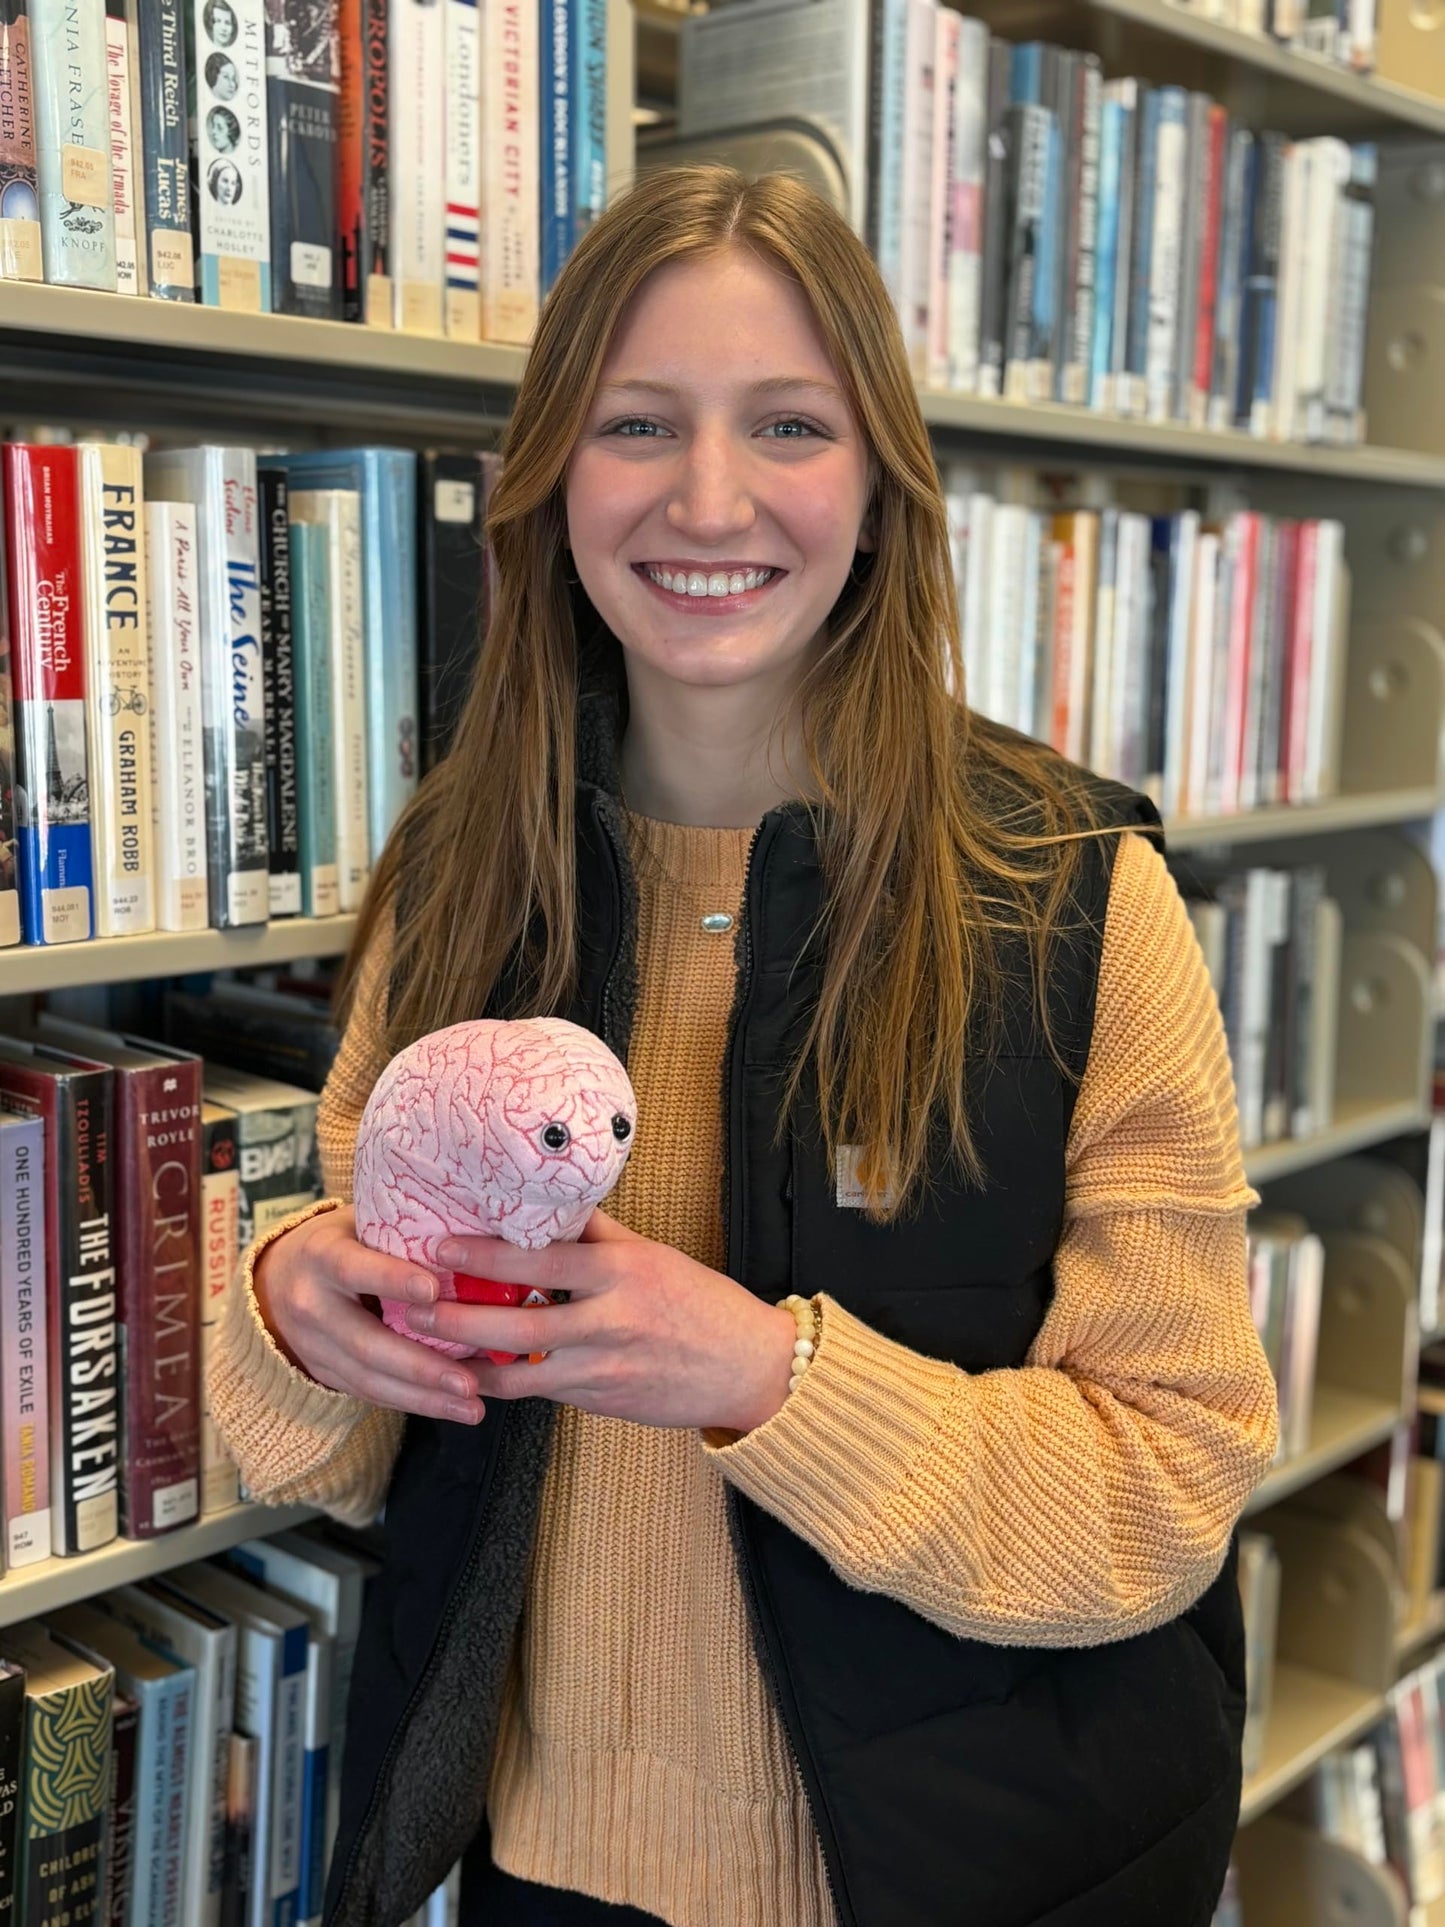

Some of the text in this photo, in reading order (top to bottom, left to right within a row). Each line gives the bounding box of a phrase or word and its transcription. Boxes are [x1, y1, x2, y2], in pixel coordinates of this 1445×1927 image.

[161, 11, 177, 68] Third
[15, 42, 31, 150] CATHERINE
[68, 65, 84, 145] FRASE
[163, 73, 180, 127] Reich
[244, 19, 262, 166] MITFORDS
[503, 5, 520, 197] VICTORIAN CITY
[107, 44, 131, 214] The Voyage of the Armada
[157, 157, 173, 220] Lucas
[176, 157, 188, 223] James
[61, 237, 105, 252] KNOPF
[117, 261, 135, 270] 42.05
[207, 225, 263, 242] CHARLOTTE
[102, 483, 139, 630] FRANCE
[175, 537, 190, 583] Paris
[272, 508, 290, 611] CHURCH
[35, 579, 55, 671] Century
[52, 595, 71, 672] French
[177, 587, 191, 613] All
[173, 619, 192, 655] Your
[226, 561, 259, 730] The Seine
[276, 634, 293, 701] MARY
[180, 660, 194, 691] Own
[119, 730, 140, 873] GRAHAM ROBB
[182, 740, 195, 828] ELEANOR
[279, 707, 298, 852] MAGDALENE
[58, 848, 67, 888] Flamm
[185, 837, 197, 874] BRO
[96, 1132, 107, 1164] TIM
[139, 1104, 200, 1126] TREVOR
[147, 1127, 195, 1148] ROYLE
[77, 1099, 90, 1204] TZOULIADIS
[79, 1212, 110, 1267] THE
[208, 1197, 228, 1299] RUSSIA
[152, 1160, 191, 1428] CRIMEA
[15, 1146, 36, 1515] ONE HUNDRED YEARS OF EXILE TANIA ROMANO
[69, 1266, 118, 1501] FORSAKEN
[14, 1540, 33, 1550] ROM
